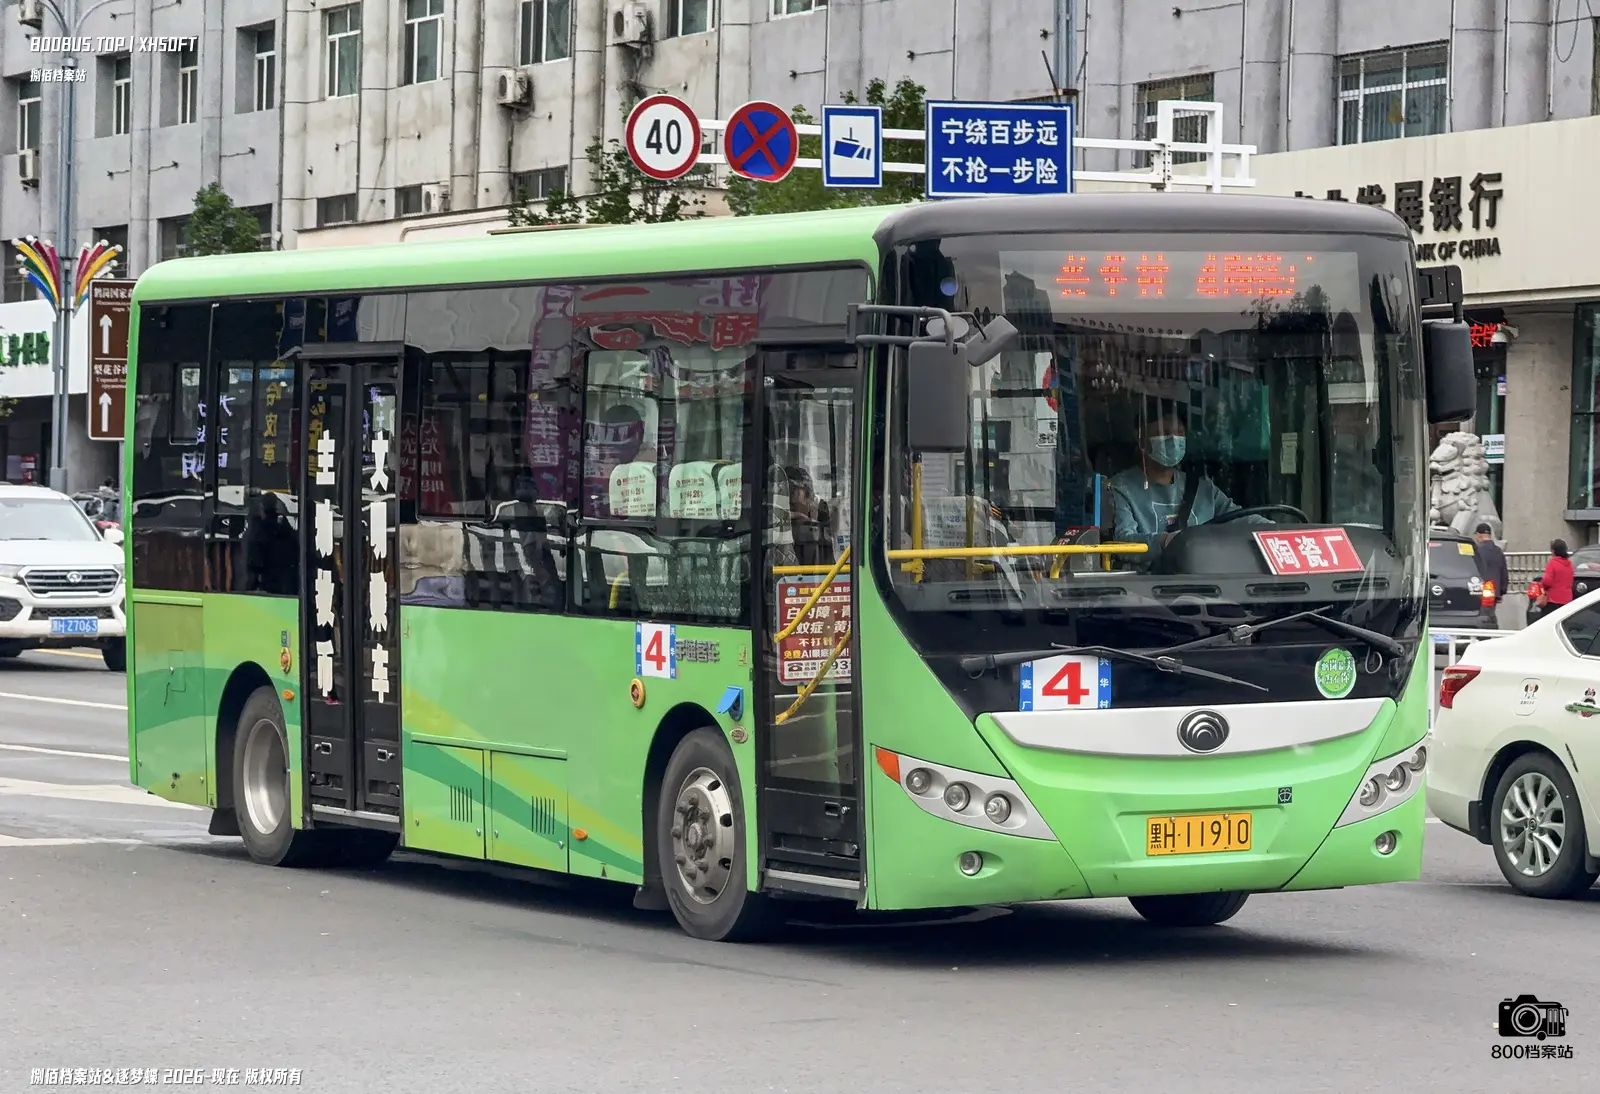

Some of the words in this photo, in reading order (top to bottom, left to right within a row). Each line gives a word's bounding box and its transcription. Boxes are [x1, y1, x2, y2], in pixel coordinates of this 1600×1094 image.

[646, 119, 682, 155] 40
[941, 118, 1058, 147] 宁绕百步远
[941, 156, 1058, 185] 不抢一步险
[1438, 241, 1457, 261] OF
[1459, 237, 1502, 260] CHINA
[1265, 535, 1351, 570] 陶瓷厂
[645, 630, 666, 671] 4
[1042, 662, 1090, 705] 4
[1150, 819, 1249, 849] 黑H·11910
